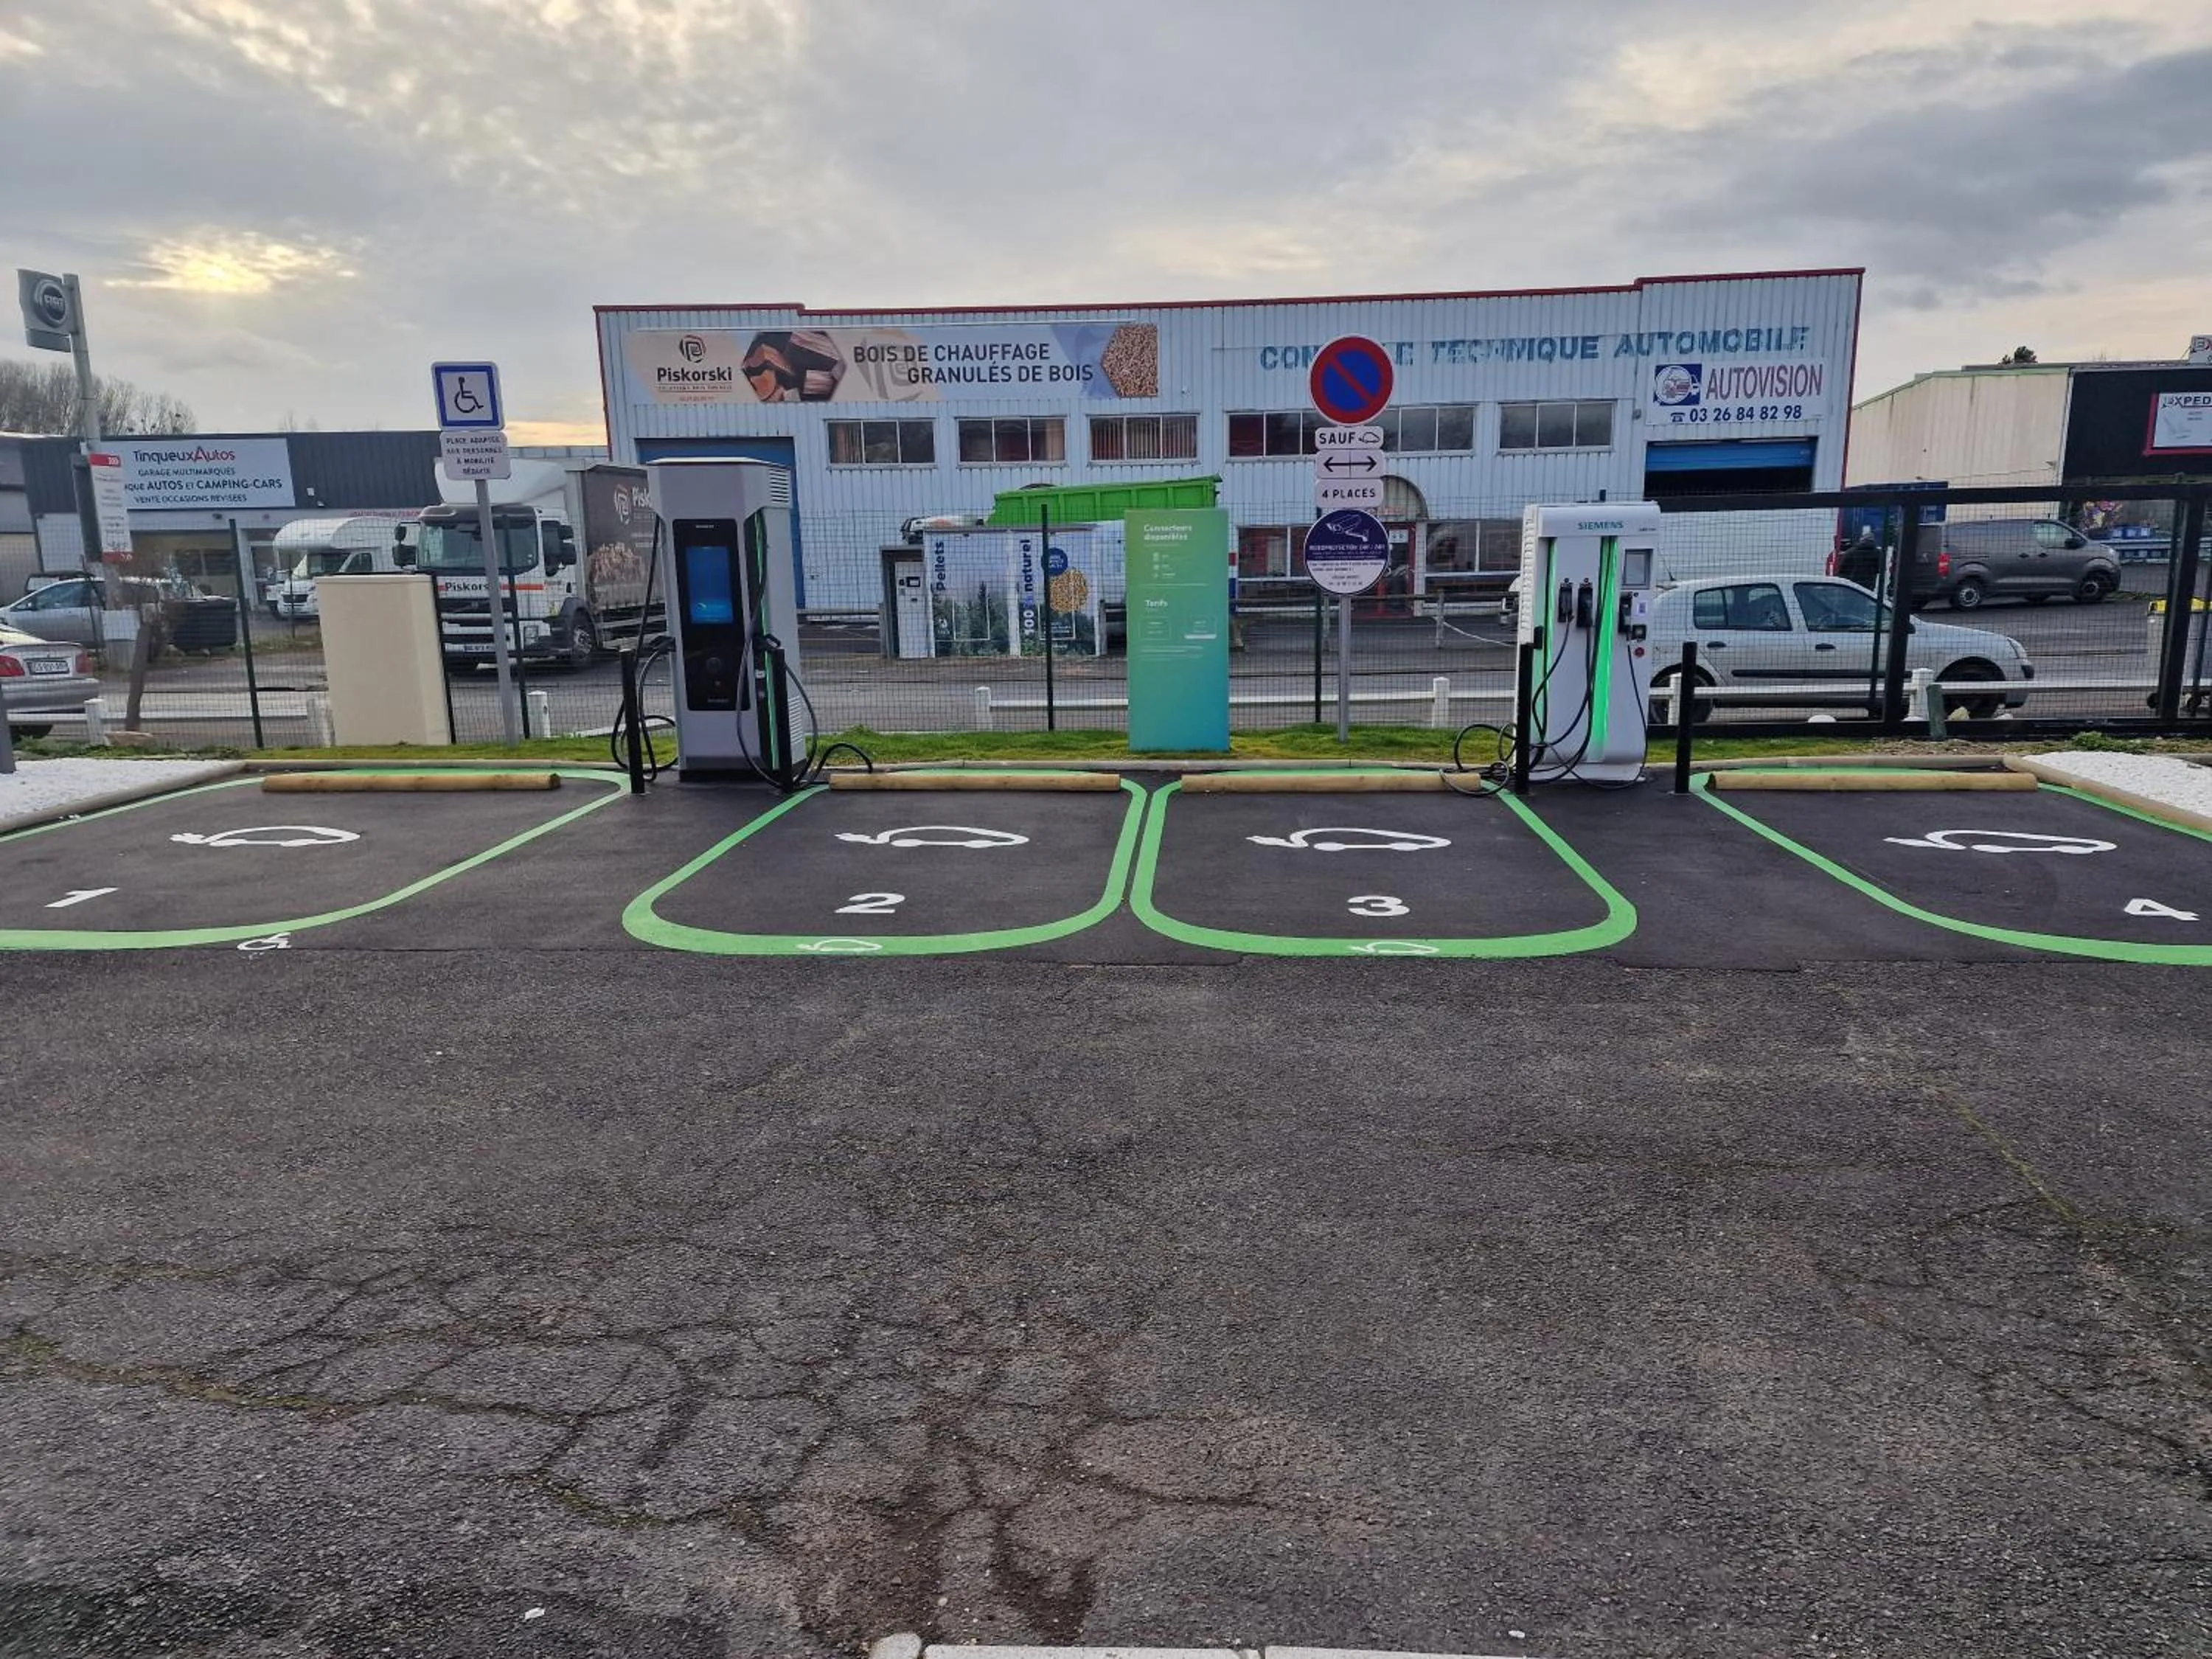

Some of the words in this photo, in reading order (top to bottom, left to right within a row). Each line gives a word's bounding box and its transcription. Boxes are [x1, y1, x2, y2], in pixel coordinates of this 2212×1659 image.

[853, 345, 897, 364] BOIS
[903, 346, 928, 362] DE
[934, 343, 1050, 362] CHAUFFAGE
[657, 366, 732, 382] Piskorski
[908, 361, 1012, 383] GRANULÉS
[1018, 365, 1043, 382] DE
[1049, 365, 1093, 382] BOIS
[1705, 364, 1823, 400] AUTOVISION
[1689, 408, 1708, 422] 03
[1713, 408, 1731, 422] 26
[1736, 407, 1754, 421] 84
[1759, 406, 1778, 420] 82
[1784, 406, 1802, 420] 98
[1319, 432, 1356, 444] SAUF
[133, 445, 235, 464] TinqueuxAutos
[147, 480, 184, 490] AUTOS
[196, 479, 282, 489] CAMPING-CARS
[1321, 490, 1328, 498] 4
[1332, 488, 1376, 498] PLACES
[1578, 521, 1624, 529] SIEMENS
[934, 542, 946, 591] Pellets
[1020, 539, 1033, 592] naturel
[44, 888, 119, 908] 1
[835, 893, 905, 913] 2
[1347, 896, 1410, 916] 3
[2124, 898, 2200, 921] 4
